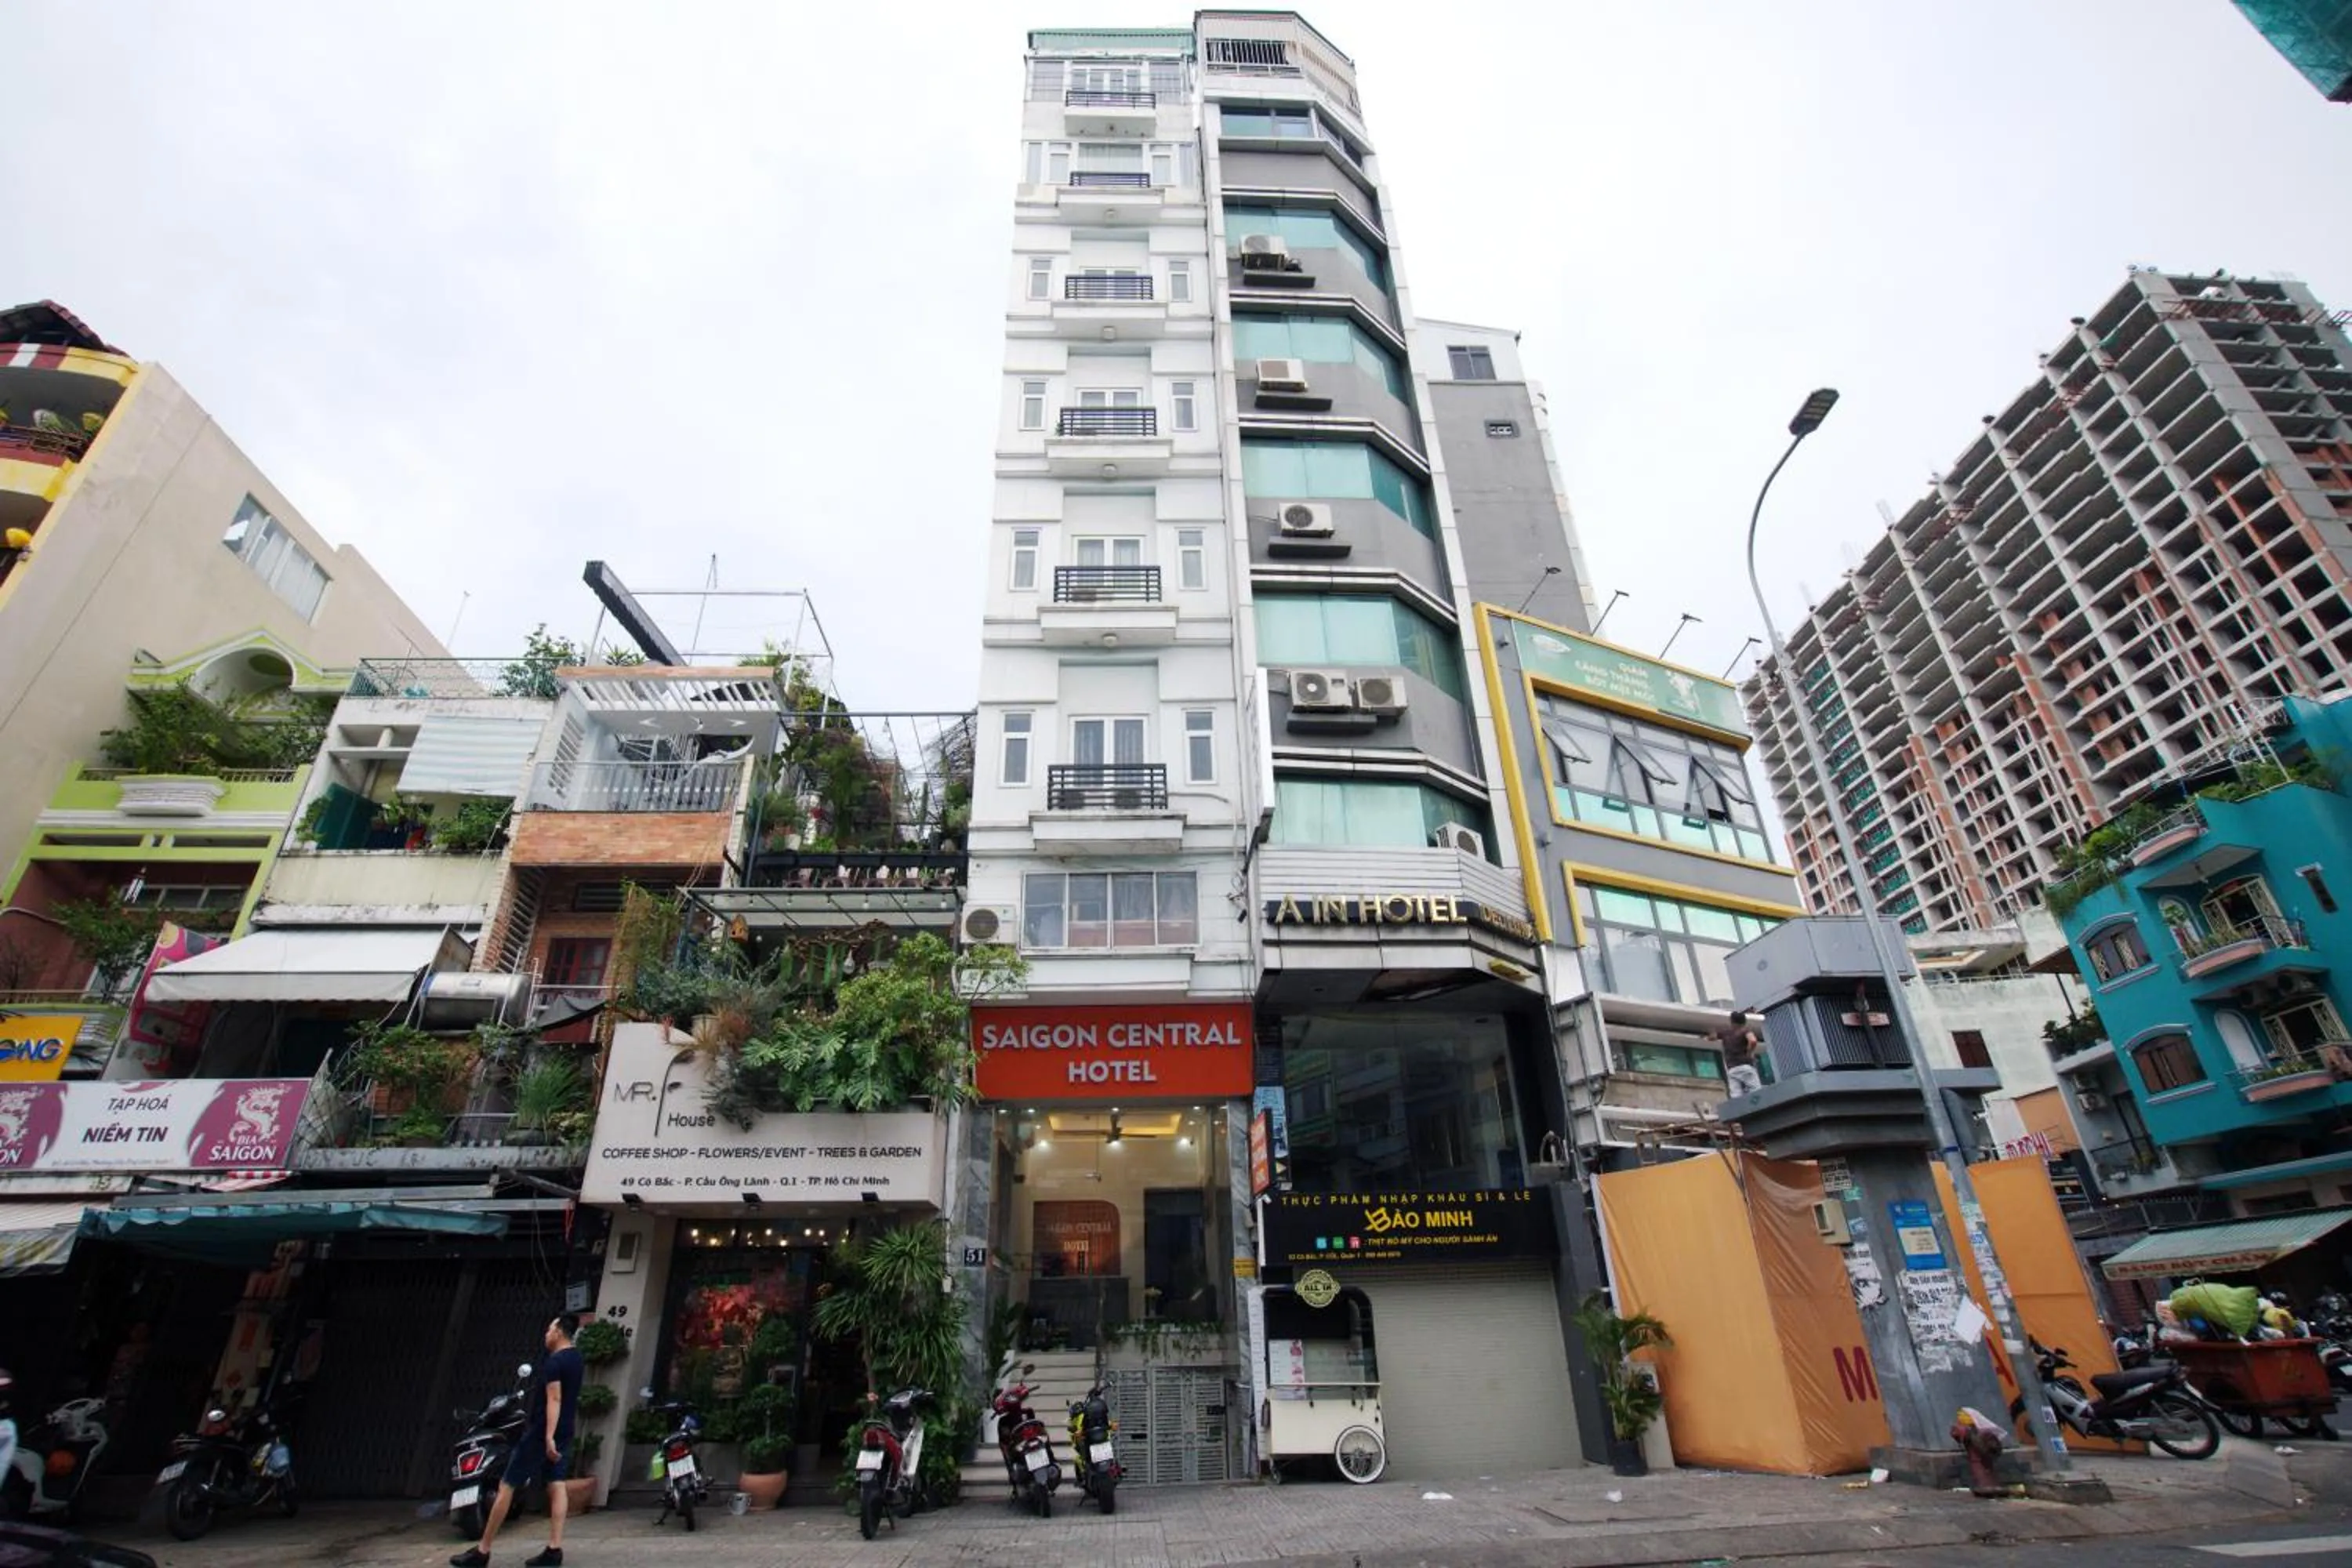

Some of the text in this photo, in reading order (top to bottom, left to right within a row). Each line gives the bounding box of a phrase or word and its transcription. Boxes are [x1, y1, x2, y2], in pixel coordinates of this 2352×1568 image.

[1276, 893, 1468, 924] A IN HOTEL
[982, 1021, 1243, 1049] SAIGON CENTRAL
[1068, 1060, 1158, 1083] HOTEL
[614, 1081, 656, 1102] MR.
[107, 1097, 136, 1115] TẠP
[667, 1111, 716, 1127] House
[136, 1127, 169, 1143] TIN
[236, 1134, 258, 1145] BIA
[209, 1145, 278, 1162] SAIGON
[602, 1147, 652, 1159] COFFEE
[652, 1147, 689, 1159] SHOP
[698, 1146, 806, 1160] FLOWERS/EVENT
[817, 1147, 857, 1159] TREES
[858, 1147, 868, 1158] &
[869, 1146, 922, 1158] GARDEN
[620, 1177, 635, 1187] 49
[862, 1176, 891, 1186] Minh
[1424, 1210, 1474, 1228] MINH
[965, 1249, 983, 1263] 51
[608, 1305, 628, 1318] 49
